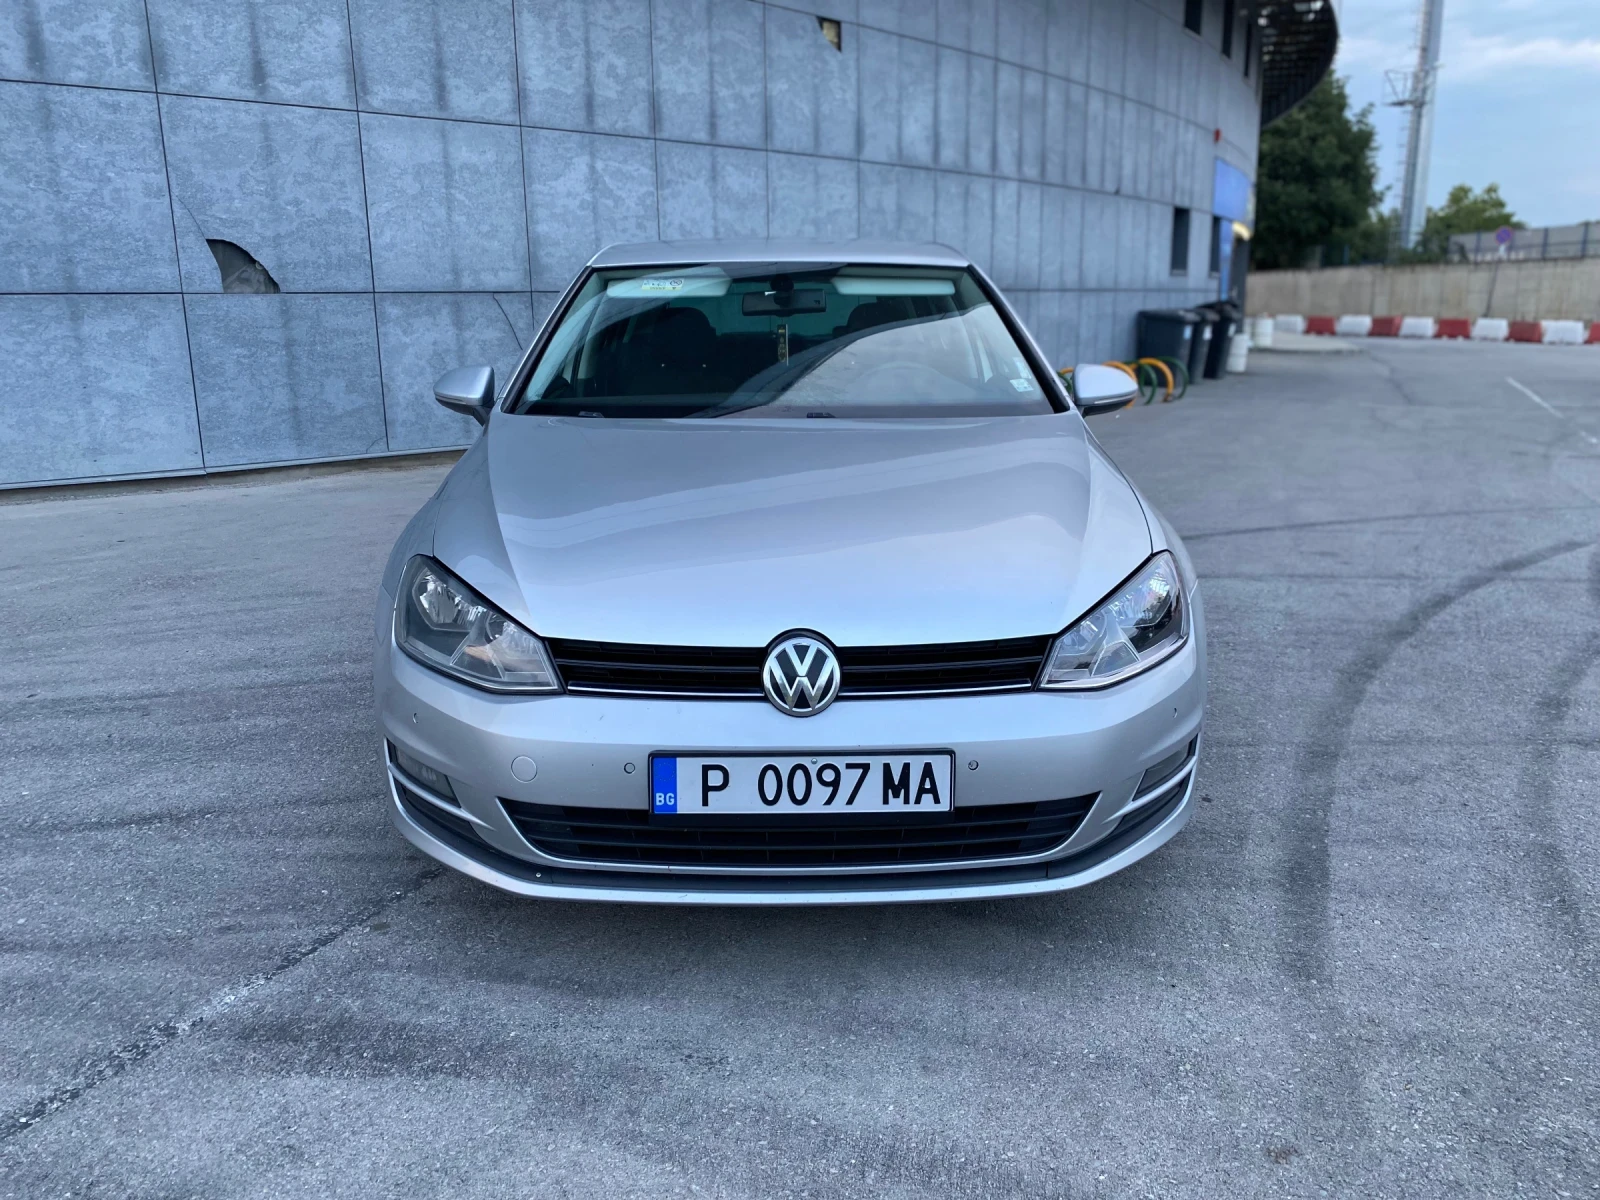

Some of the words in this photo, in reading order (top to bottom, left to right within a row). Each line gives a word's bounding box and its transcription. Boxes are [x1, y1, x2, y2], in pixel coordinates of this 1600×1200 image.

[768, 642, 835, 711] VW
[656, 793, 675, 806] BG
[701, 764, 730, 807] P
[757, 763, 871, 806] 0097
[882, 762, 941, 805] MA
